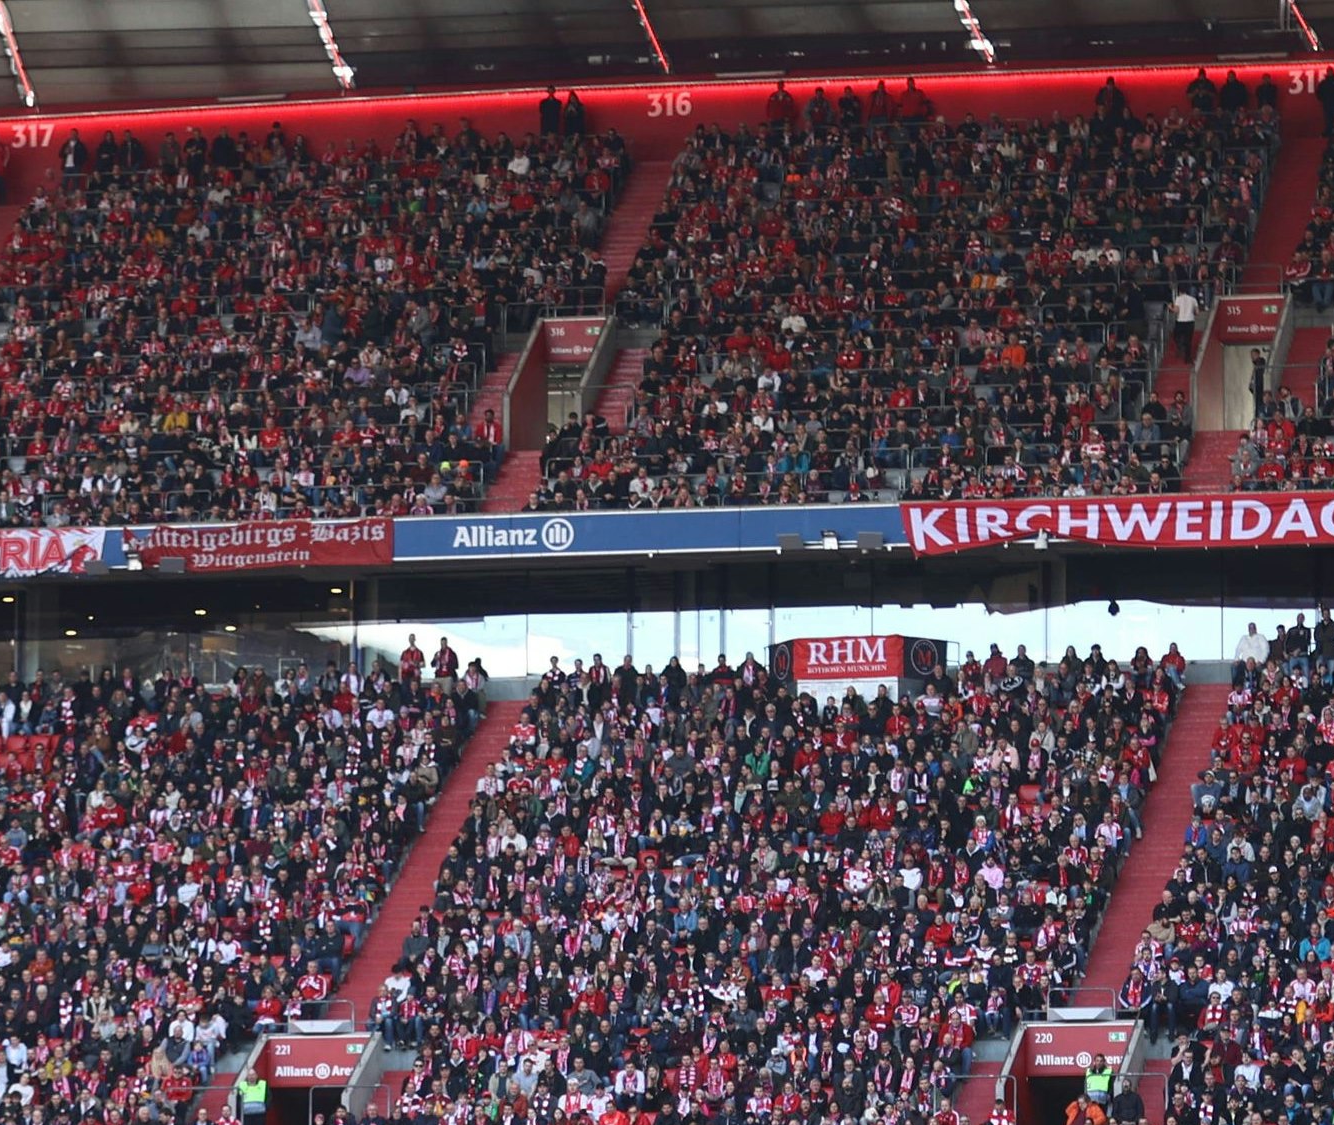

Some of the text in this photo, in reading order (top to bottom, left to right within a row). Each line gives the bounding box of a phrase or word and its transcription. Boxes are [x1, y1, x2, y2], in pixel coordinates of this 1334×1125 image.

[647, 92, 692, 115] 316
[11, 124, 55, 147] 317
[453, 525, 537, 548] Allianz
[807, 637, 887, 665] RHM
[1034, 1033, 1053, 1043] 220
[275, 1044, 291, 1055] 221
[1035, 1054, 1074, 1066] Allianz
[275, 1063, 314, 1077] Allianz
